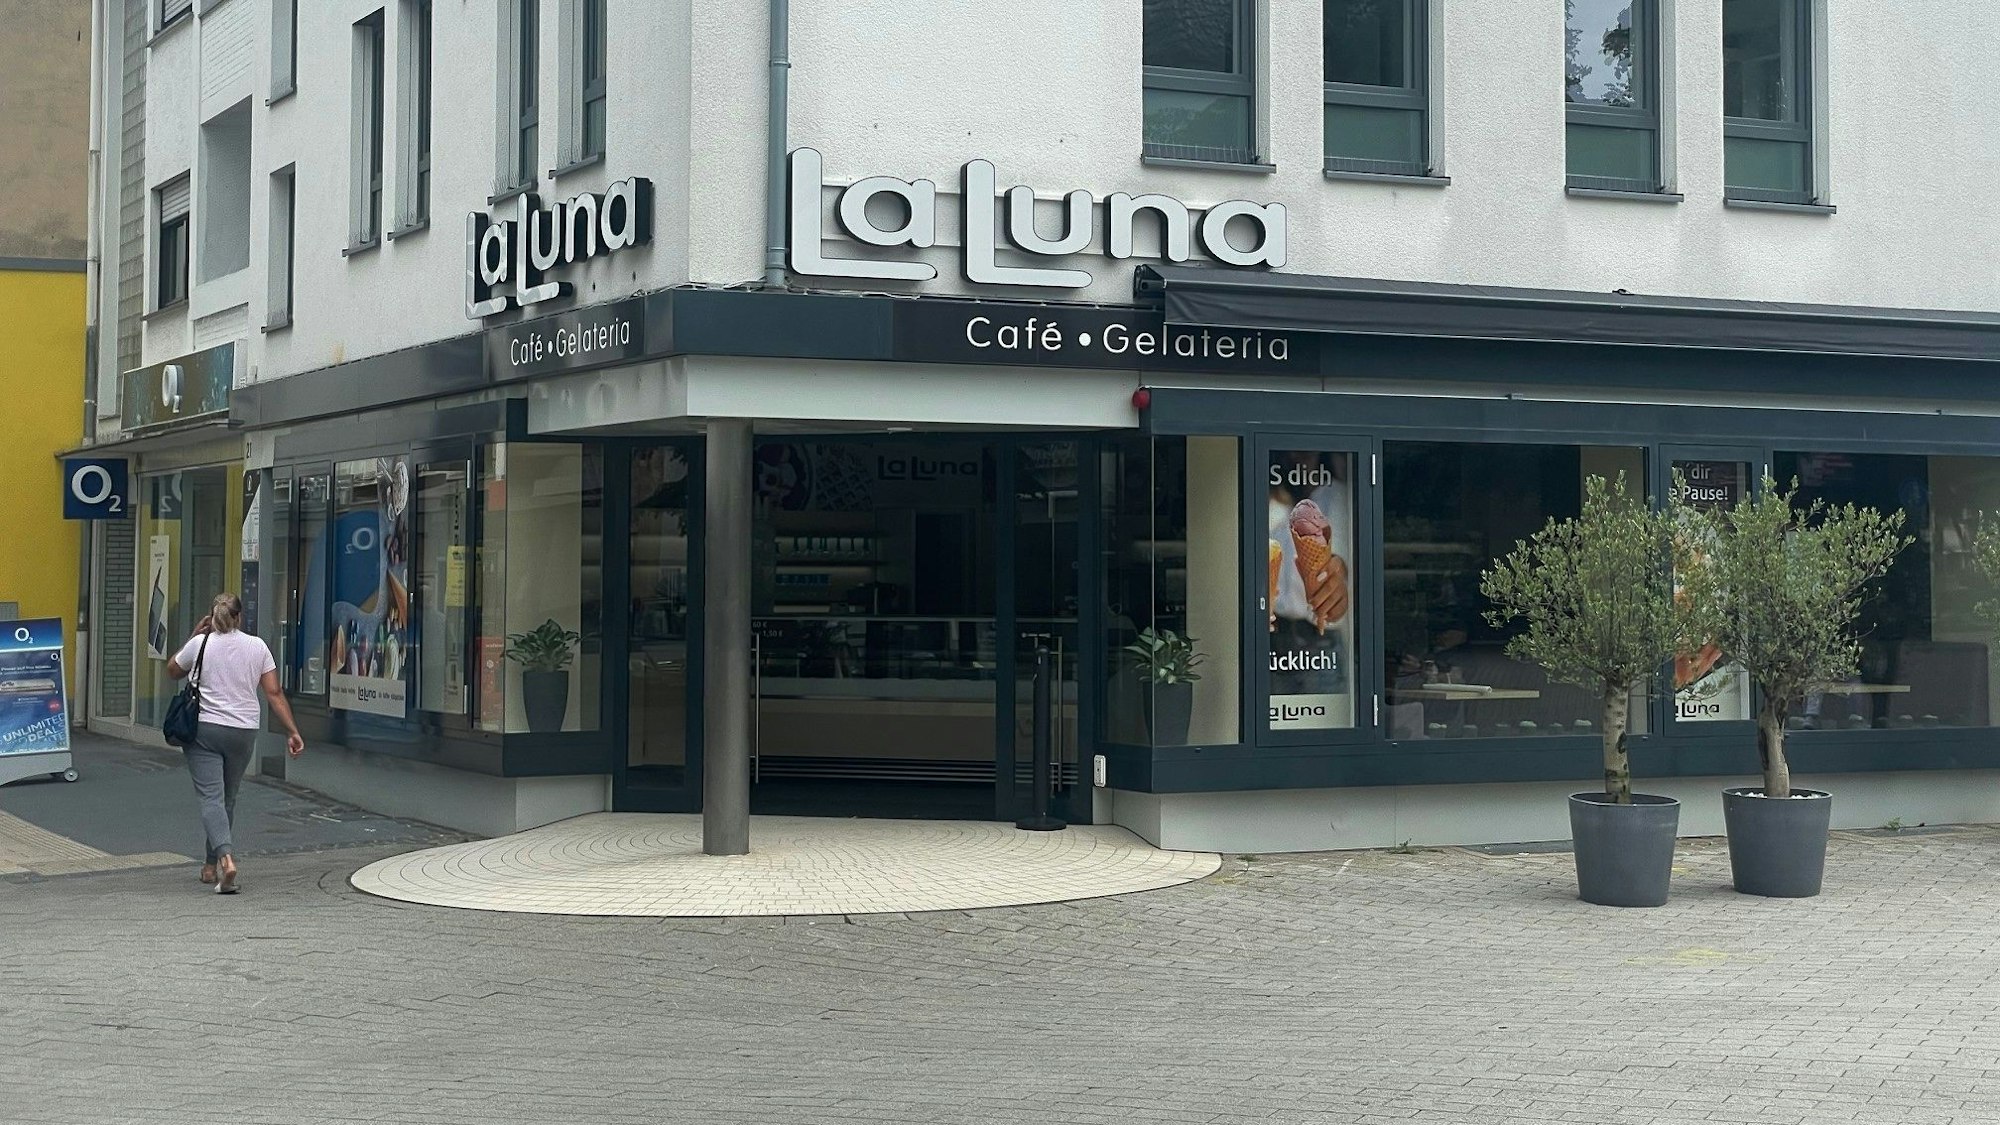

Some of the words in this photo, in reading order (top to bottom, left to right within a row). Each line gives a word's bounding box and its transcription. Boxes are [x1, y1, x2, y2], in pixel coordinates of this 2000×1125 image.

[510, 333, 543, 367] Café
[555, 317, 631, 358] Gelateria
[966, 316, 1063, 352] Café
[1102, 322, 1289, 361] Gelateria
[246, 442, 252, 459] 21
[1287, 463, 1332, 486] dich
[71, 464, 122, 512] O2
[1682, 486, 1728, 501] Pause!
[15, 627, 34, 644] O2
[1269, 650, 1337, 671] ücklich!
